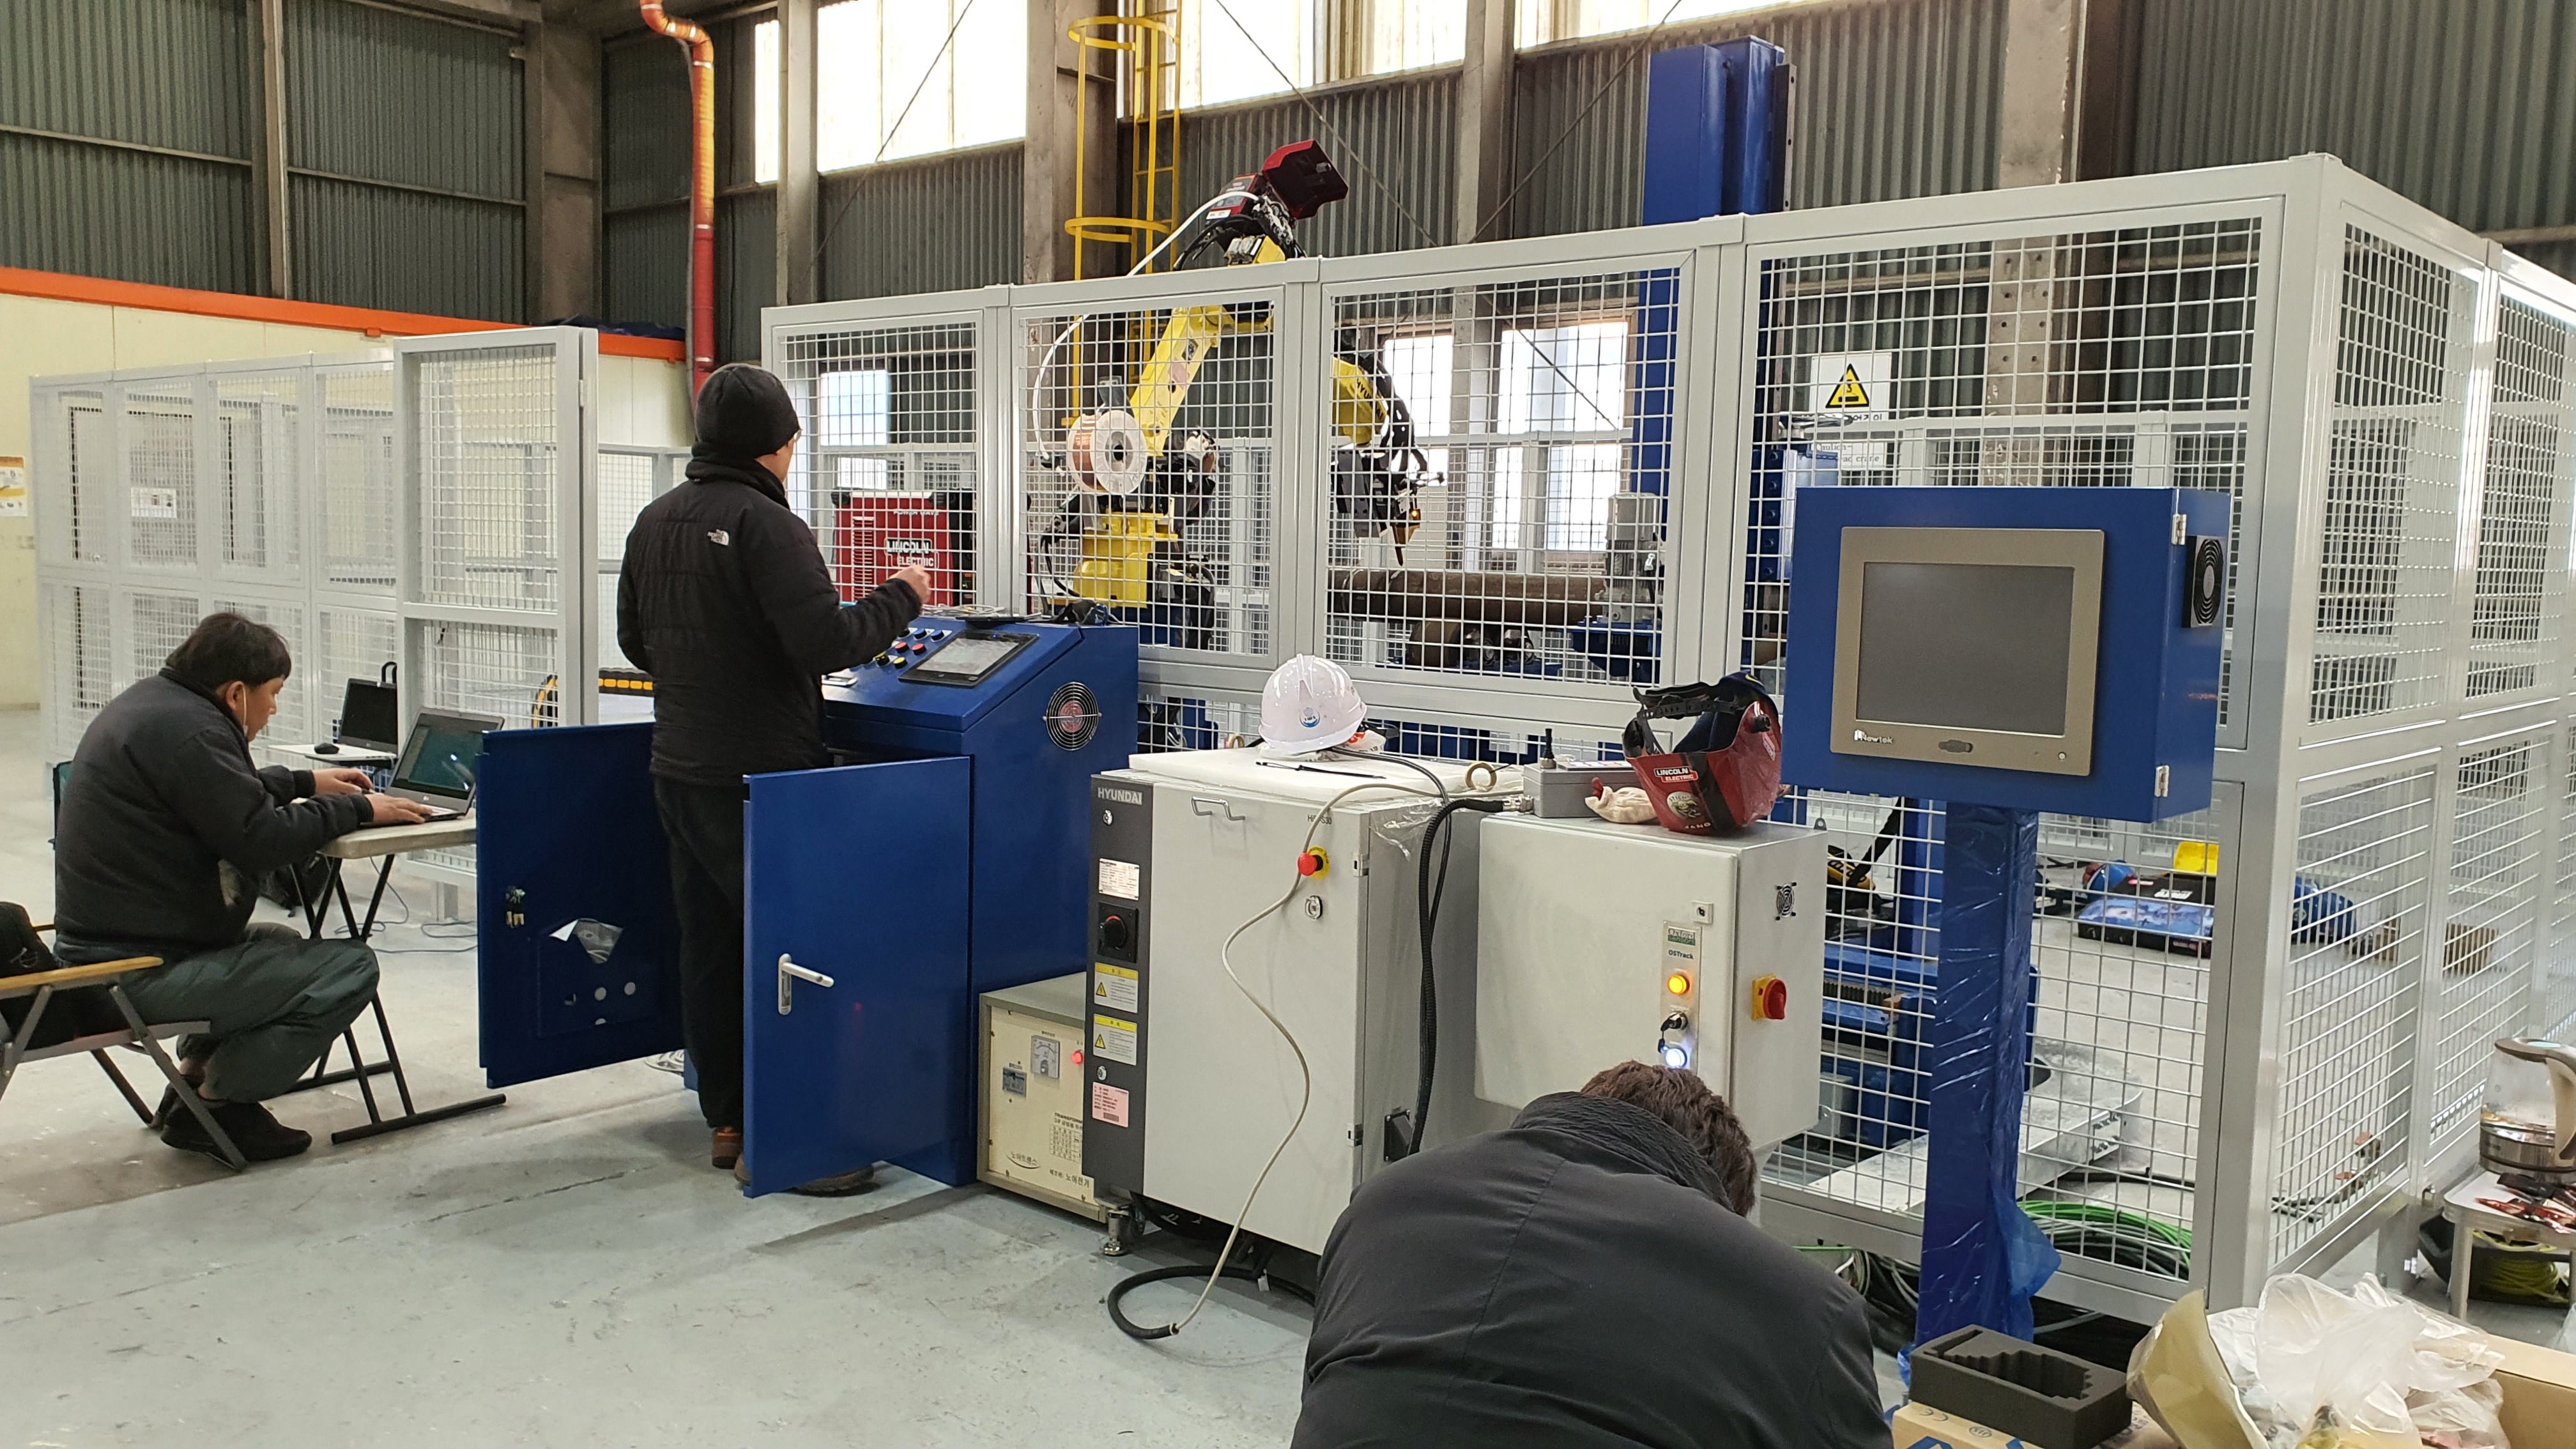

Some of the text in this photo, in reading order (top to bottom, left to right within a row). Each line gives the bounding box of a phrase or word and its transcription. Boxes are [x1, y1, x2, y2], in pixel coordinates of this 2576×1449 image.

[887, 540, 930, 554] LINCOLN
[899, 556, 934, 567] ELECTRIC
[1861, 734, 1893, 744] Newtek
[1656, 767, 1689, 776] LINCOLN
[1098, 787, 1142, 805] HYUNDAI
[1667, 928, 1696, 940] Oxford
[1668, 949, 1694, 960] OSTrack
